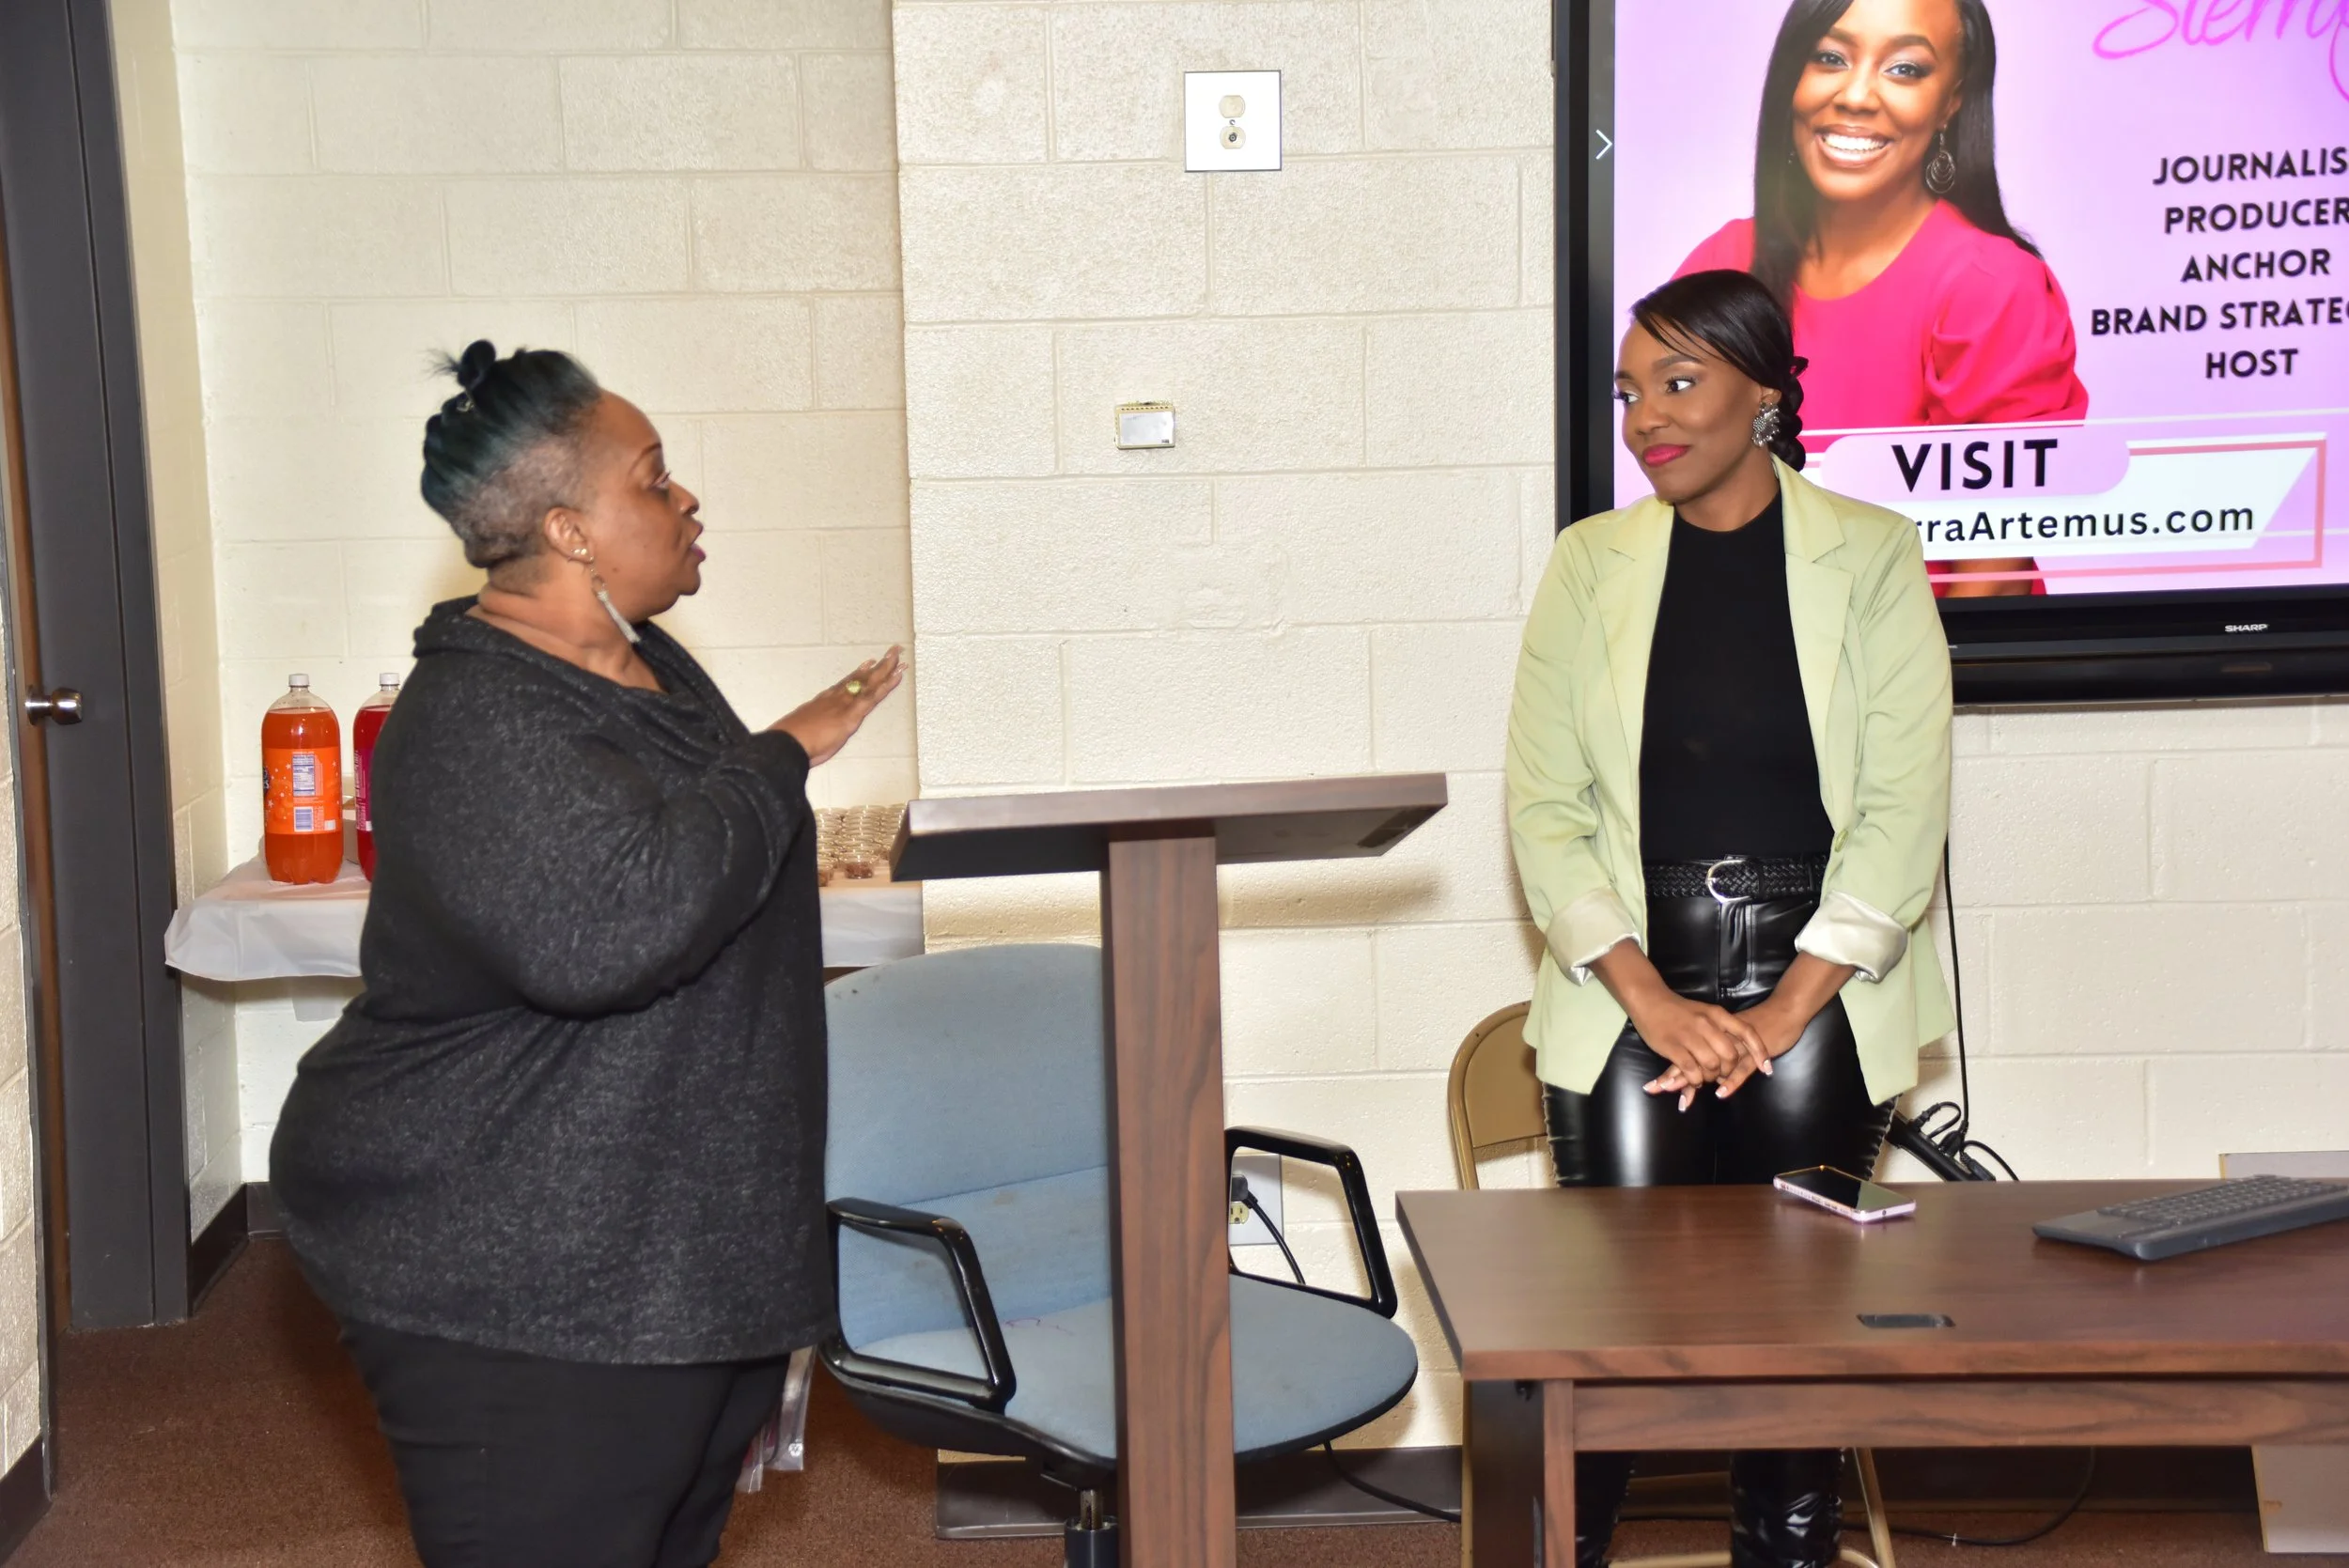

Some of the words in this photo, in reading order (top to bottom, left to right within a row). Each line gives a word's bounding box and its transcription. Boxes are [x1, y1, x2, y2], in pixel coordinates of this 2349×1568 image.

[2153, 146, 2348, 185] JOURNALIS
[2164, 196, 2349, 234] PRODUCER
[2180, 248, 2331, 283] ANCHOR
[2091, 304, 2207, 335] BRAND
[2219, 296, 2349, 329] STRATE
[2205, 349, 2299, 379] HOST
[1890, 439, 2059, 493] VISIT
[1916, 506, 2254, 542] raArtemus.com
[2224, 623, 2269, 632] SHARP
